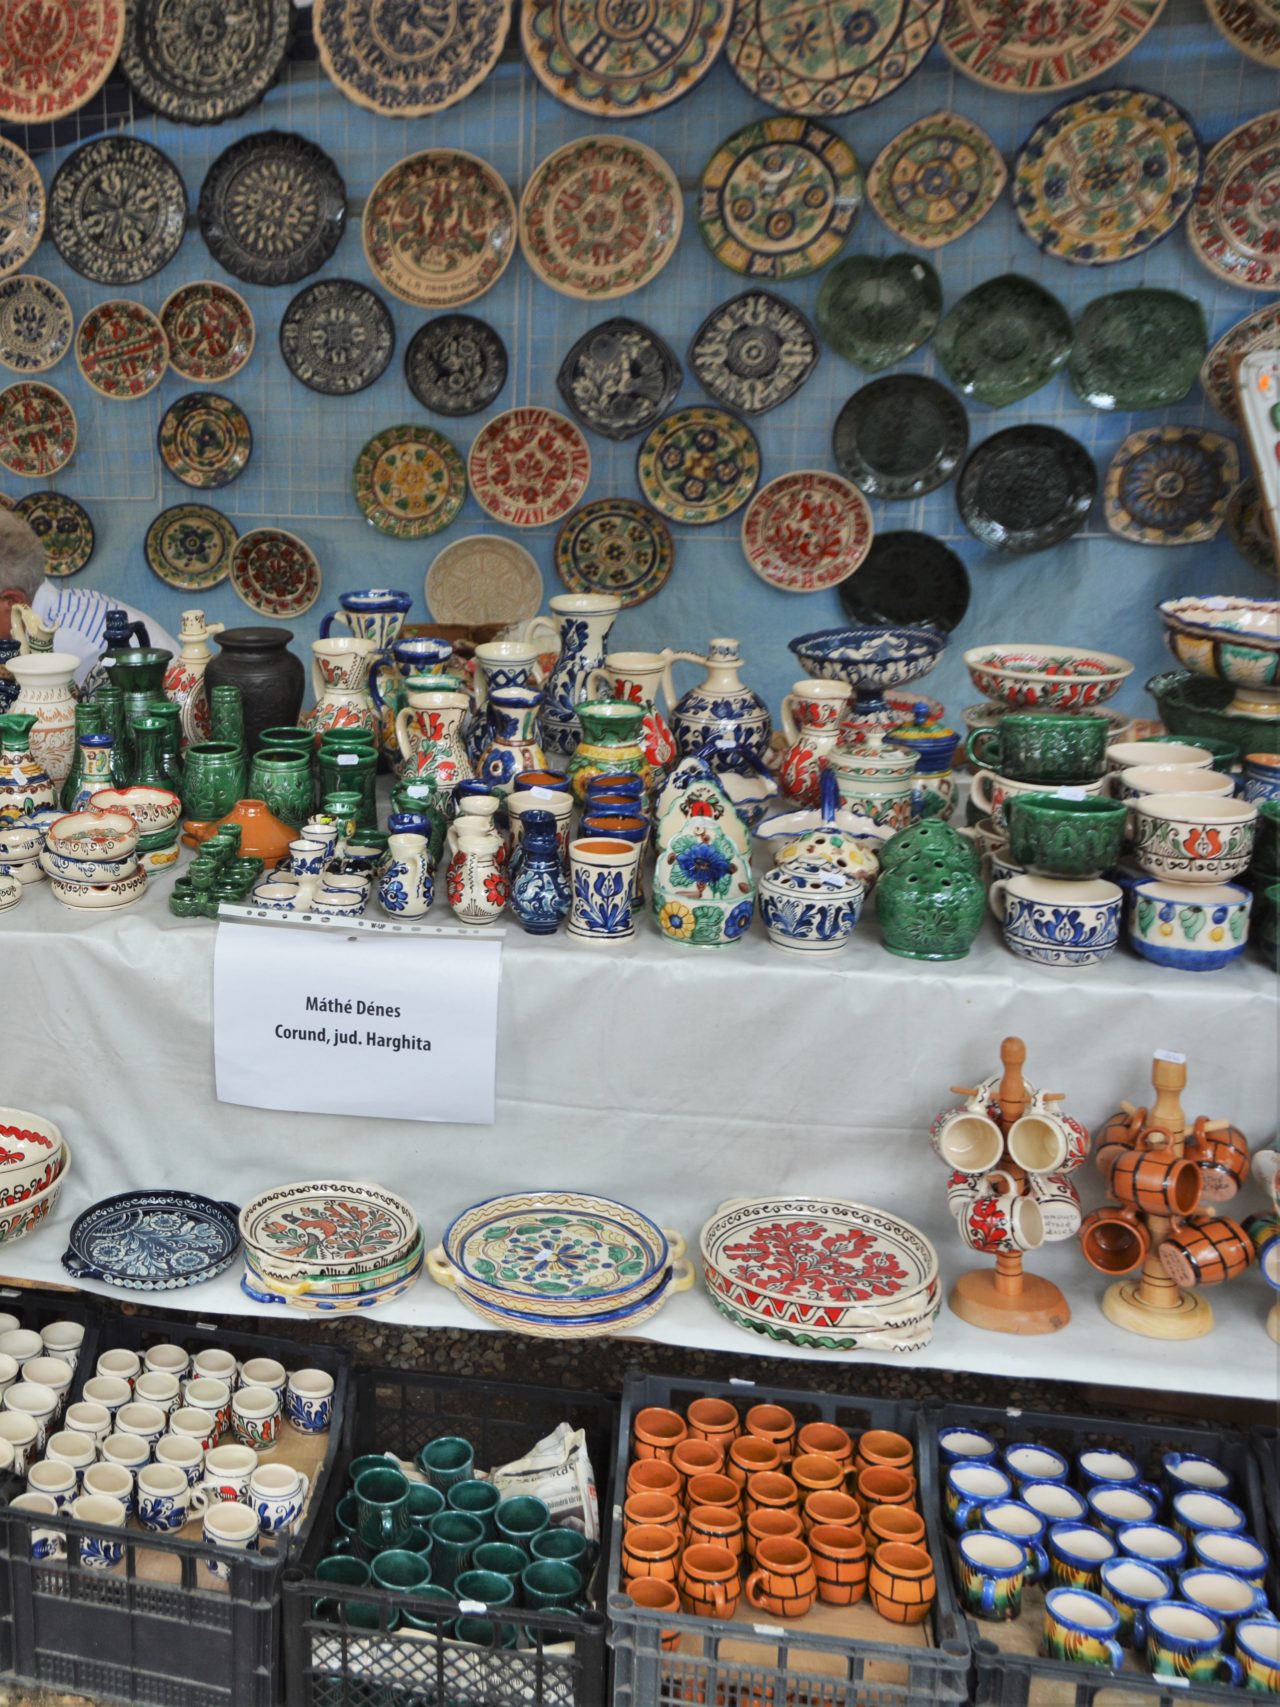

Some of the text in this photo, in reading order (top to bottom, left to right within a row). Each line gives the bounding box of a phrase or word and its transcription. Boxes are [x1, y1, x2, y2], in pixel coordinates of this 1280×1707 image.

[305, 996, 401, 1018] Máthé Dénes
[274, 1024, 432, 1053] Corund, jud. Harghita
